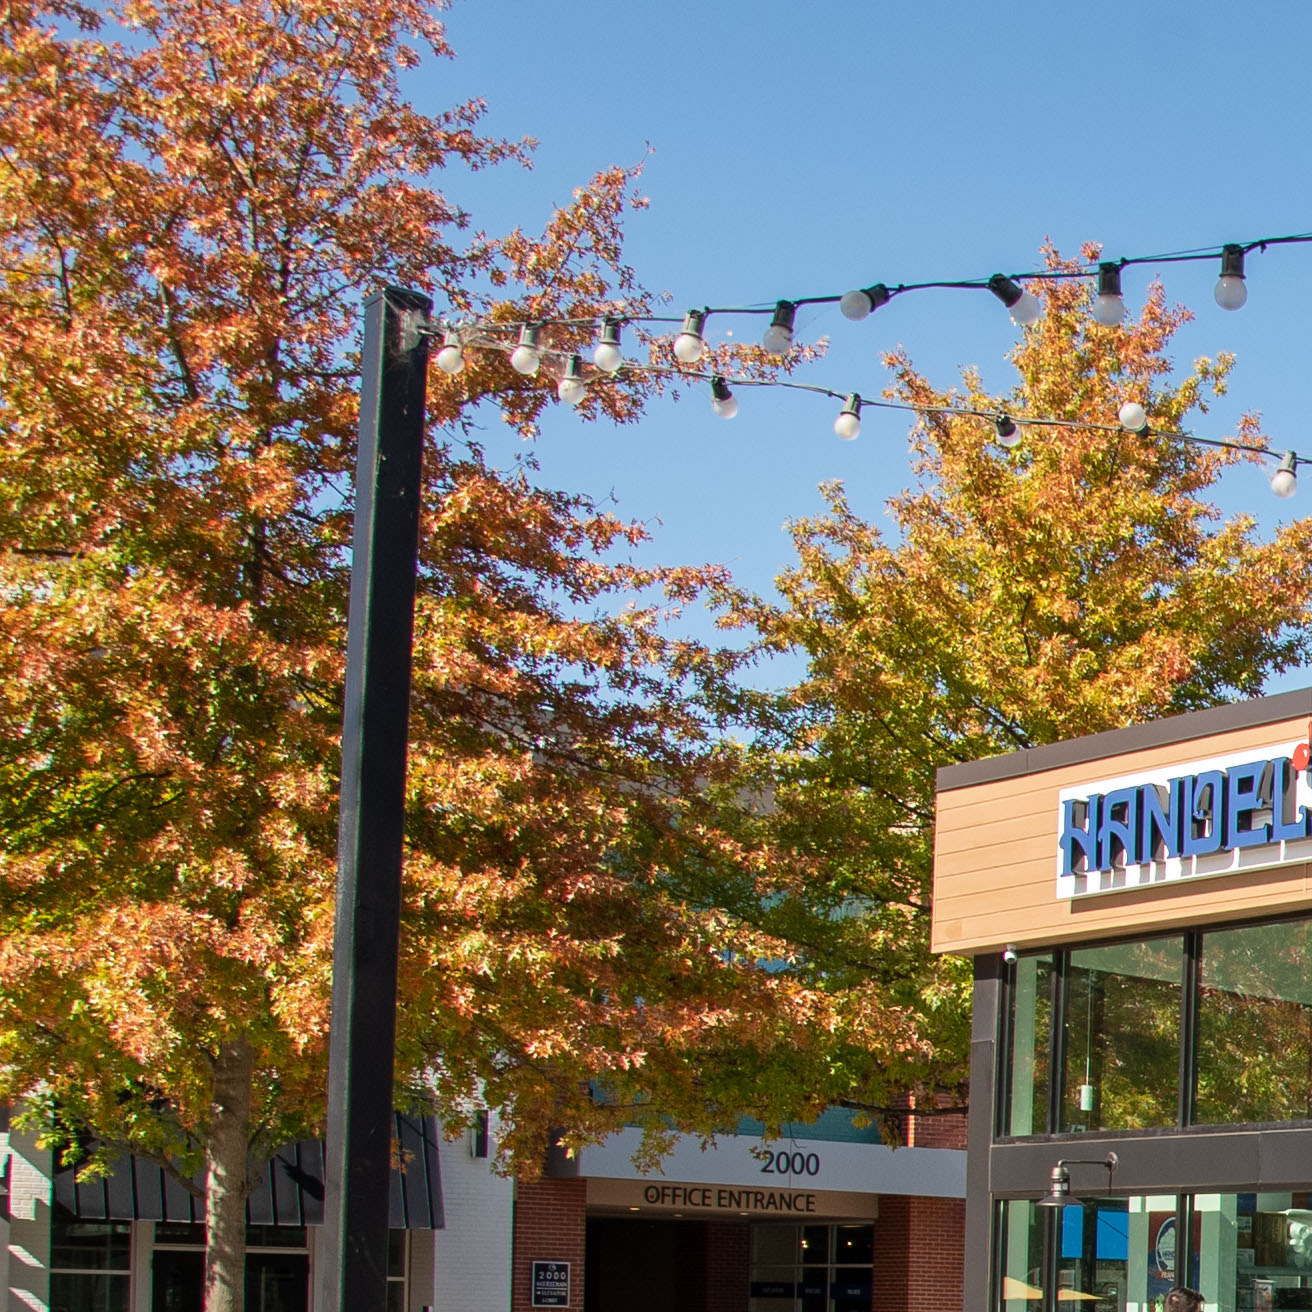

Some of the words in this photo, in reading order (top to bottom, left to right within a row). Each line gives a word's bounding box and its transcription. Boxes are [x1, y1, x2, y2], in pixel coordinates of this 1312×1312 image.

[760, 1150, 820, 1176] 2000
[644, 1185, 712, 1207] OFFICE
[717, 1189, 816, 1212] ENTRANCE
[539, 1271, 566, 1280] 2000
